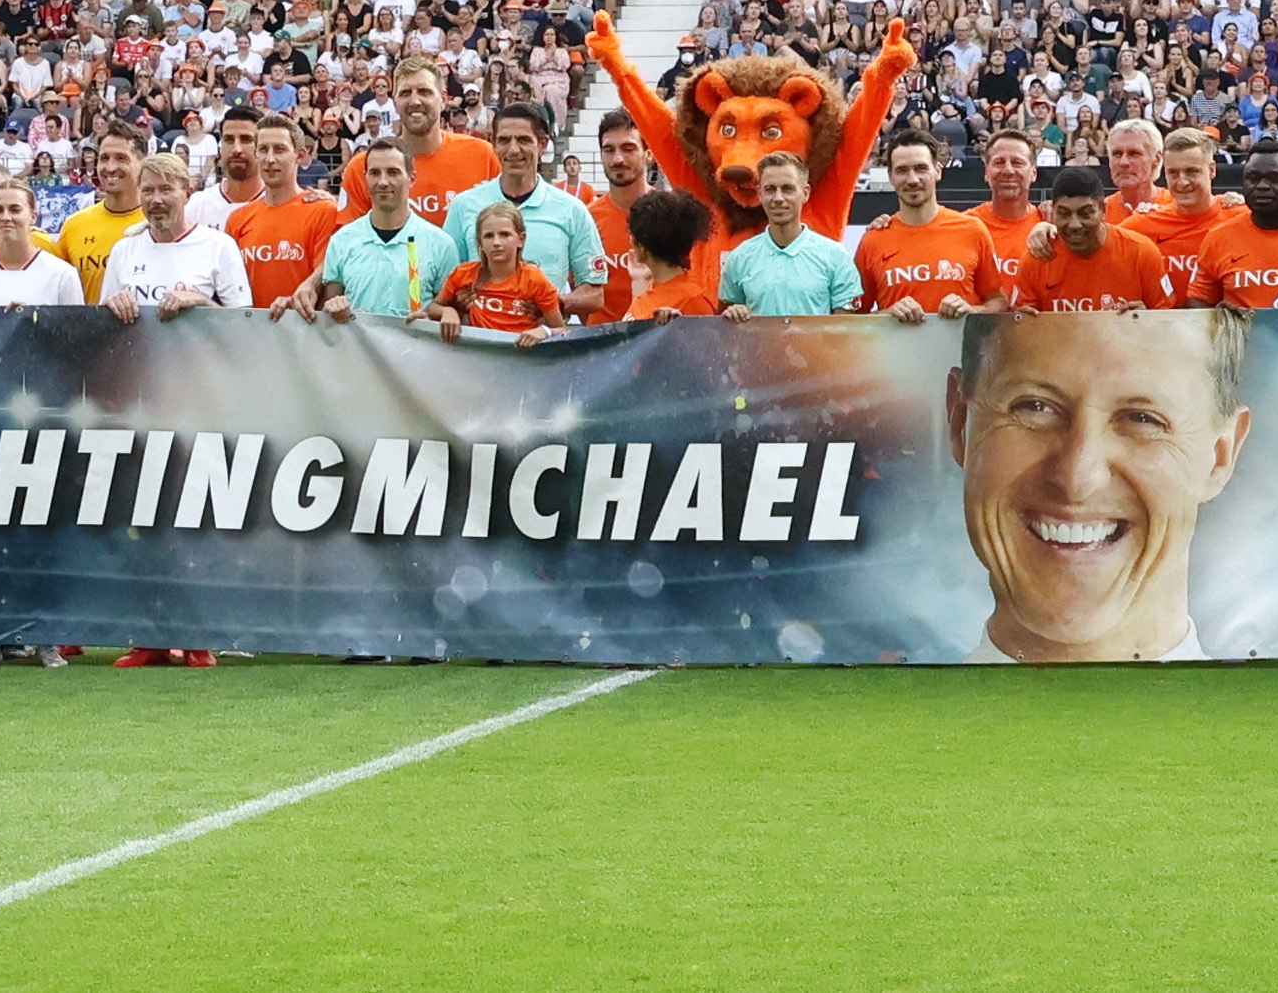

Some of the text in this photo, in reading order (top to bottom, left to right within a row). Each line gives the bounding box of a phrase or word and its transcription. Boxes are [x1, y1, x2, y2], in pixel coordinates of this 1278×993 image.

[407, 195, 439, 213] NG
[241, 244, 273, 264] NG
[604, 252, 630, 269] NG
[885, 264, 931, 287] ING
[129, 284, 168, 302] NG
[474, 295, 503, 313] NG
[1052, 297, 1094, 313] ING
